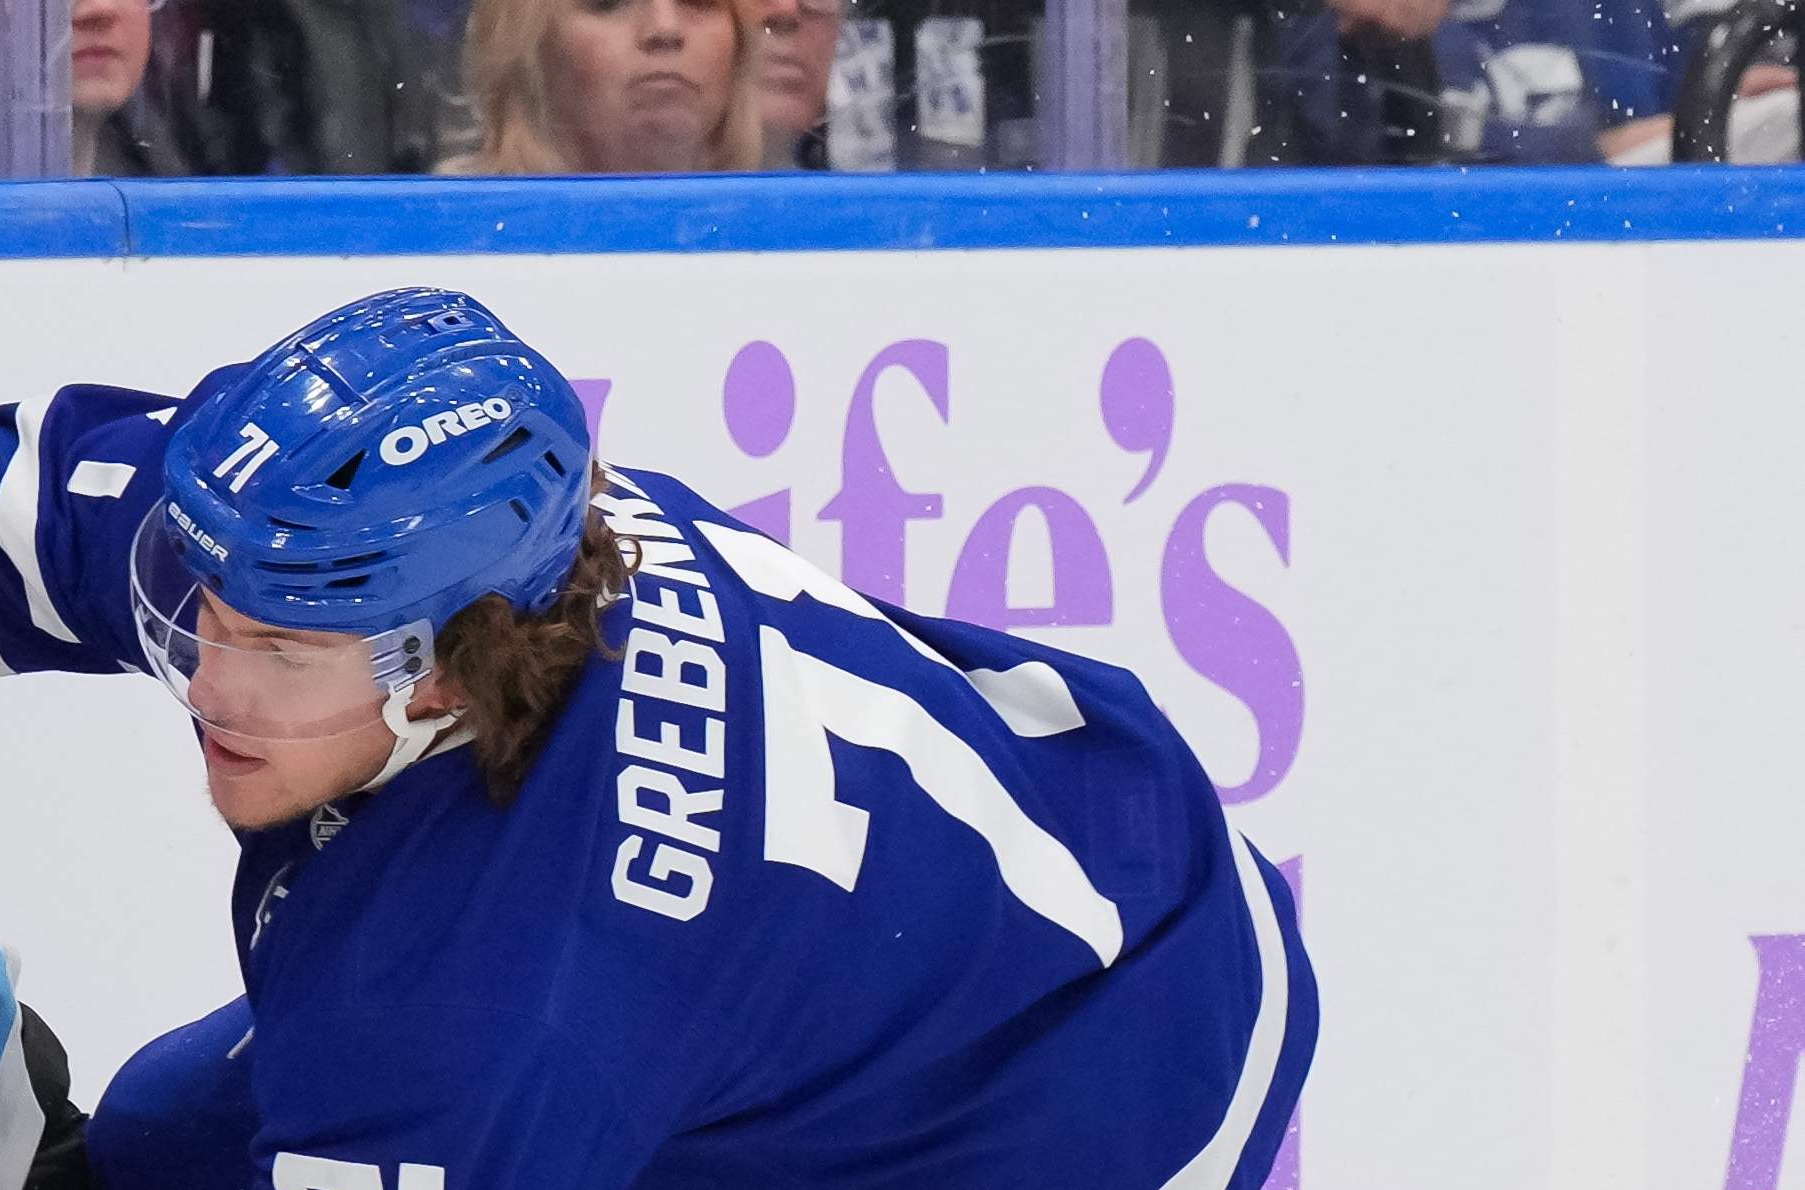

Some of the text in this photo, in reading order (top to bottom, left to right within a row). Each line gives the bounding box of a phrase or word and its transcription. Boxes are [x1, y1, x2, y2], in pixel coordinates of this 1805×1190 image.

[212, 422, 280, 493] 71
[379, 397, 512, 465] OREO
[571, 337, 1305, 806] ife's
[589, 461, 726, 921] GREBENK
